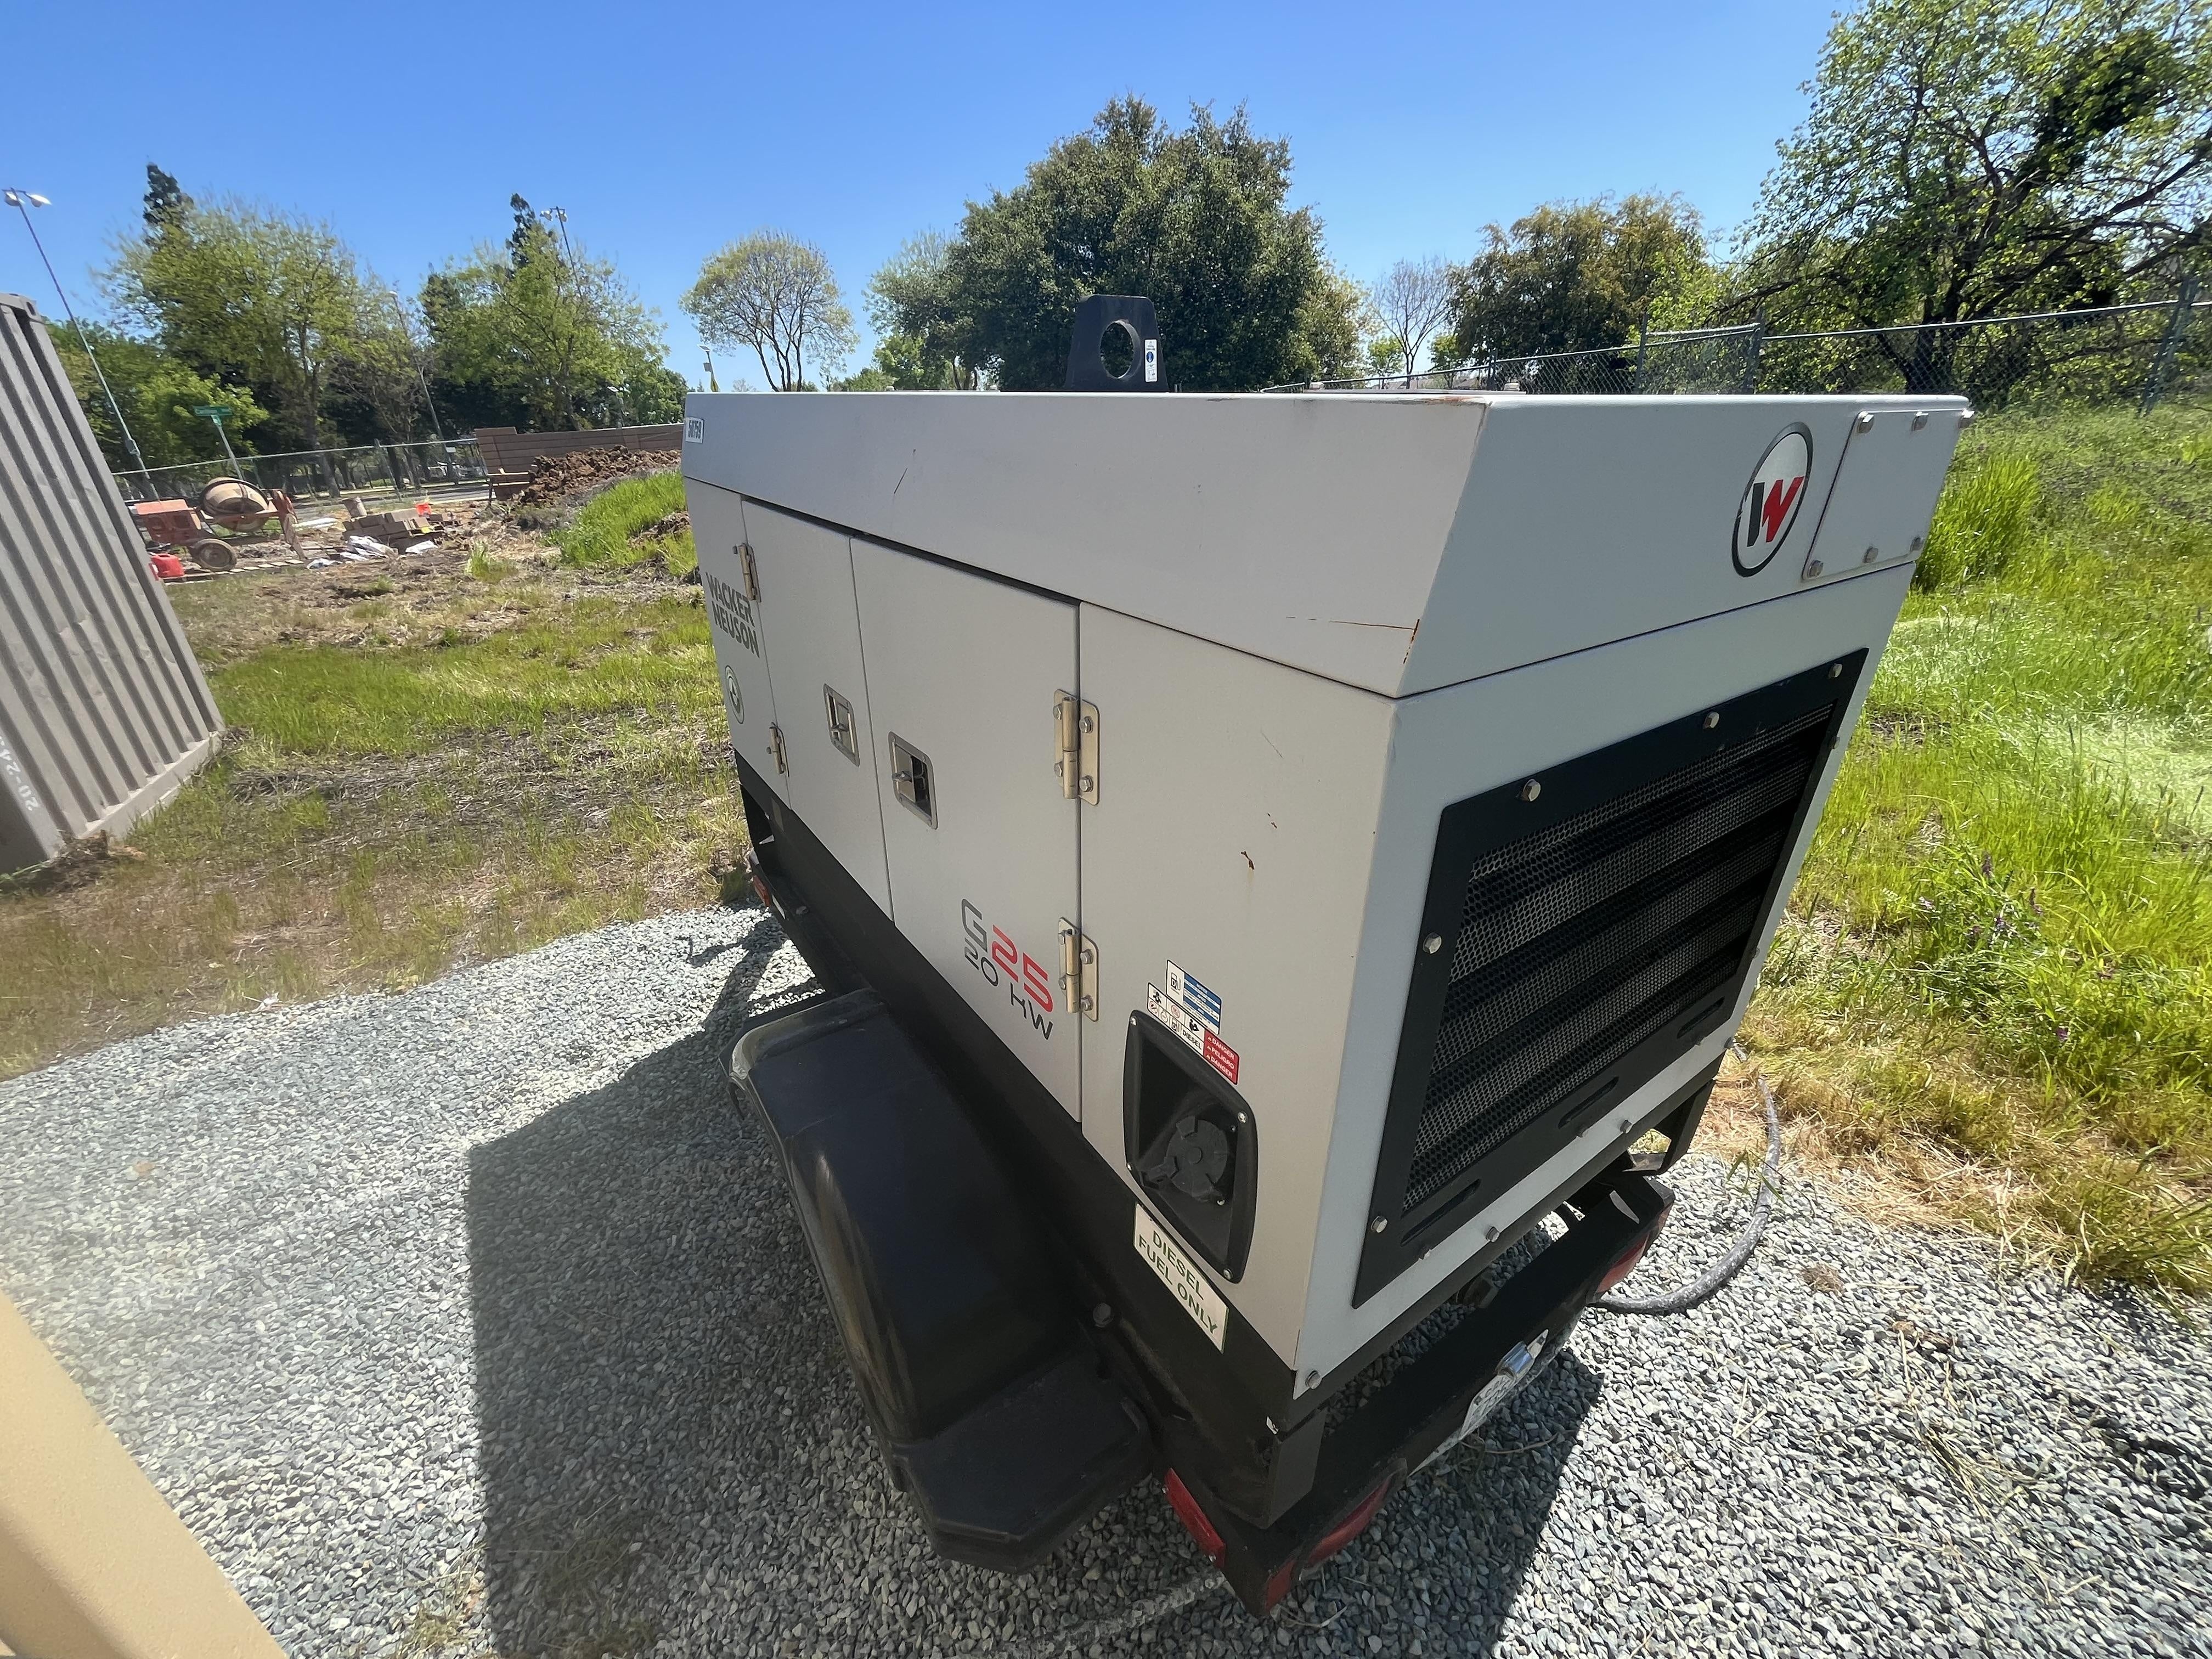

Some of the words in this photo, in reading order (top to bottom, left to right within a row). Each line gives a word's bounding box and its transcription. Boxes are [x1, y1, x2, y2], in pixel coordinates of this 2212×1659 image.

[706, 572, 755, 627] WACKER
[712, 600, 760, 658] NEUSON
[962, 898, 1053, 1013] G25
[964, 938, 999, 986] 20
[1010, 983, 1053, 1040] HW
[1182, 1029, 1202, 1051] DIESEL
[1210, 1056, 1233, 1079] DANGER
[1211, 1047, 1234, 1069] PELIGRO
[1212, 1036, 1235, 1060] DANGER
[1139, 1234, 1173, 1285] FUEL
[1177, 1284, 1218, 1335] ONLY
[1153, 1230, 1204, 1300] DIESEL
